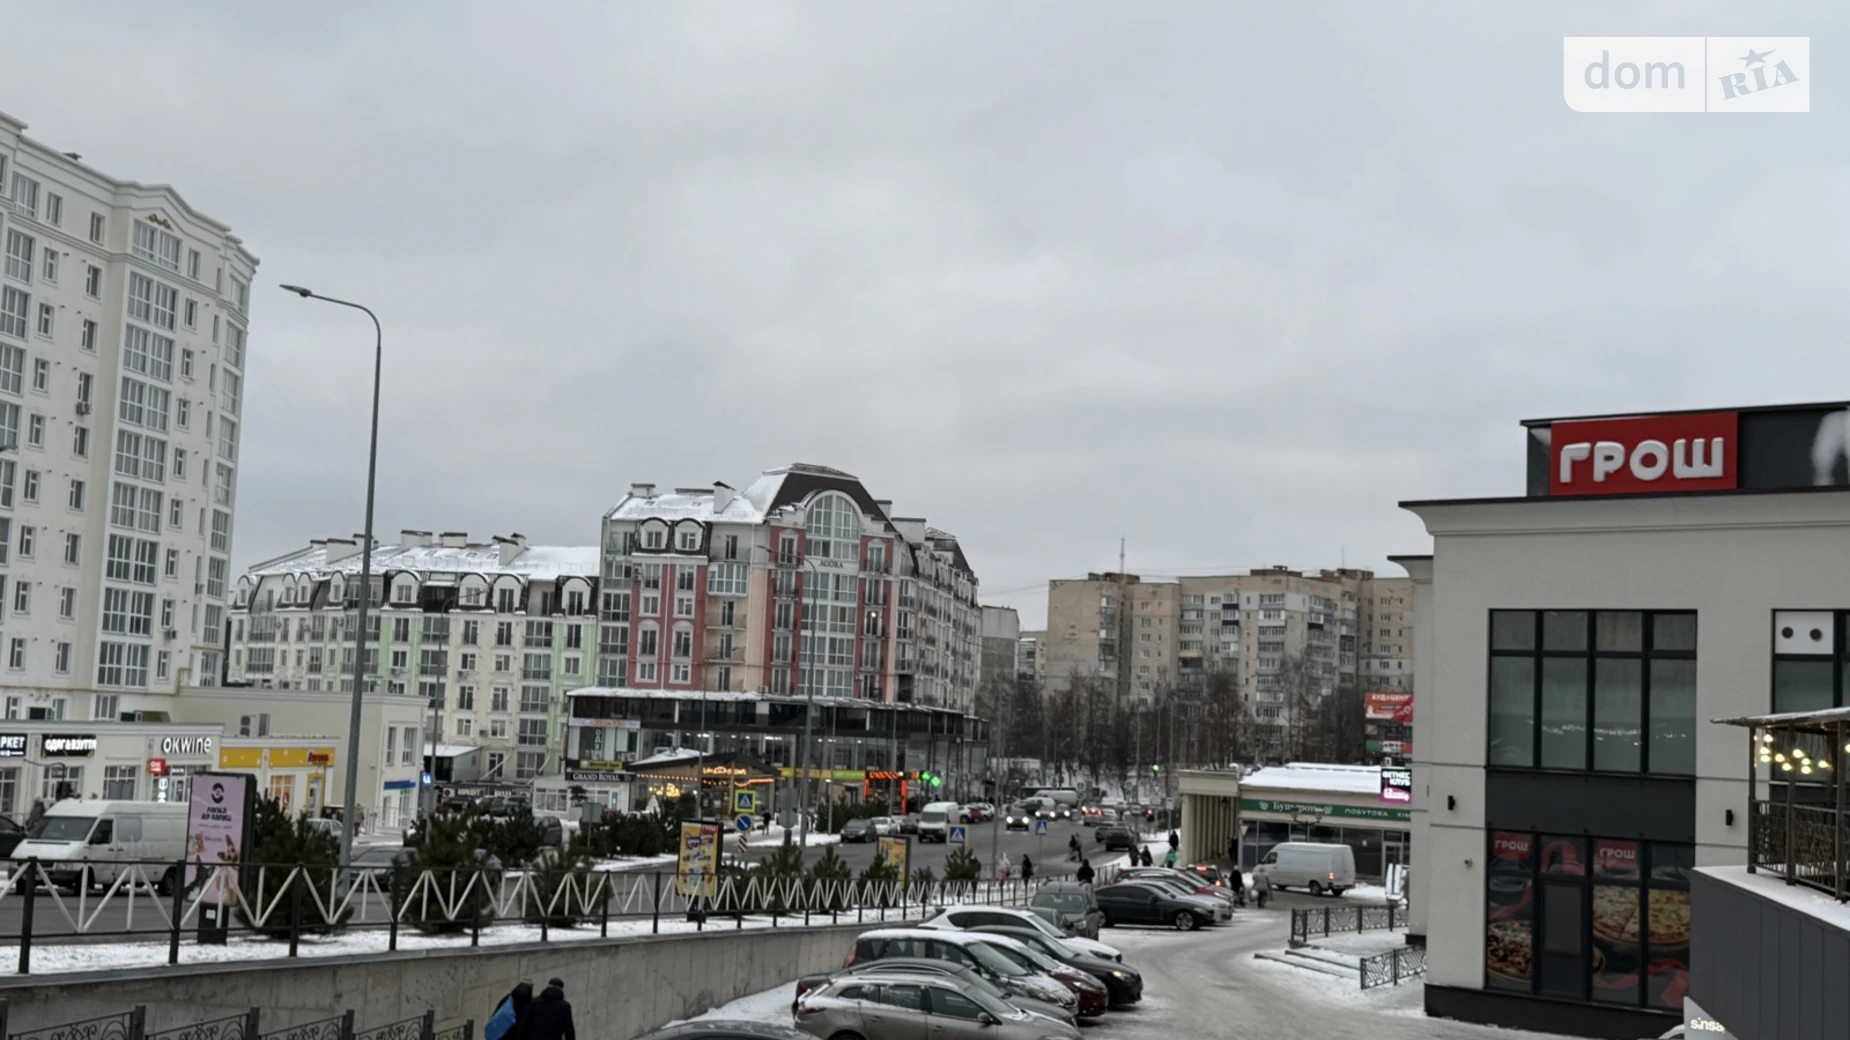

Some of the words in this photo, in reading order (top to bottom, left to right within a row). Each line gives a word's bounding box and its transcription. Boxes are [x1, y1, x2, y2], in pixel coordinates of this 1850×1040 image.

[1560, 437, 1724, 484] ГРОШ
[572, 773, 598, 781] GRAND
[598, 774, 621, 782] ROYAL
[1494, 838, 1529, 853] ГРОШ
[1599, 846, 1636, 860] ГРОШ
